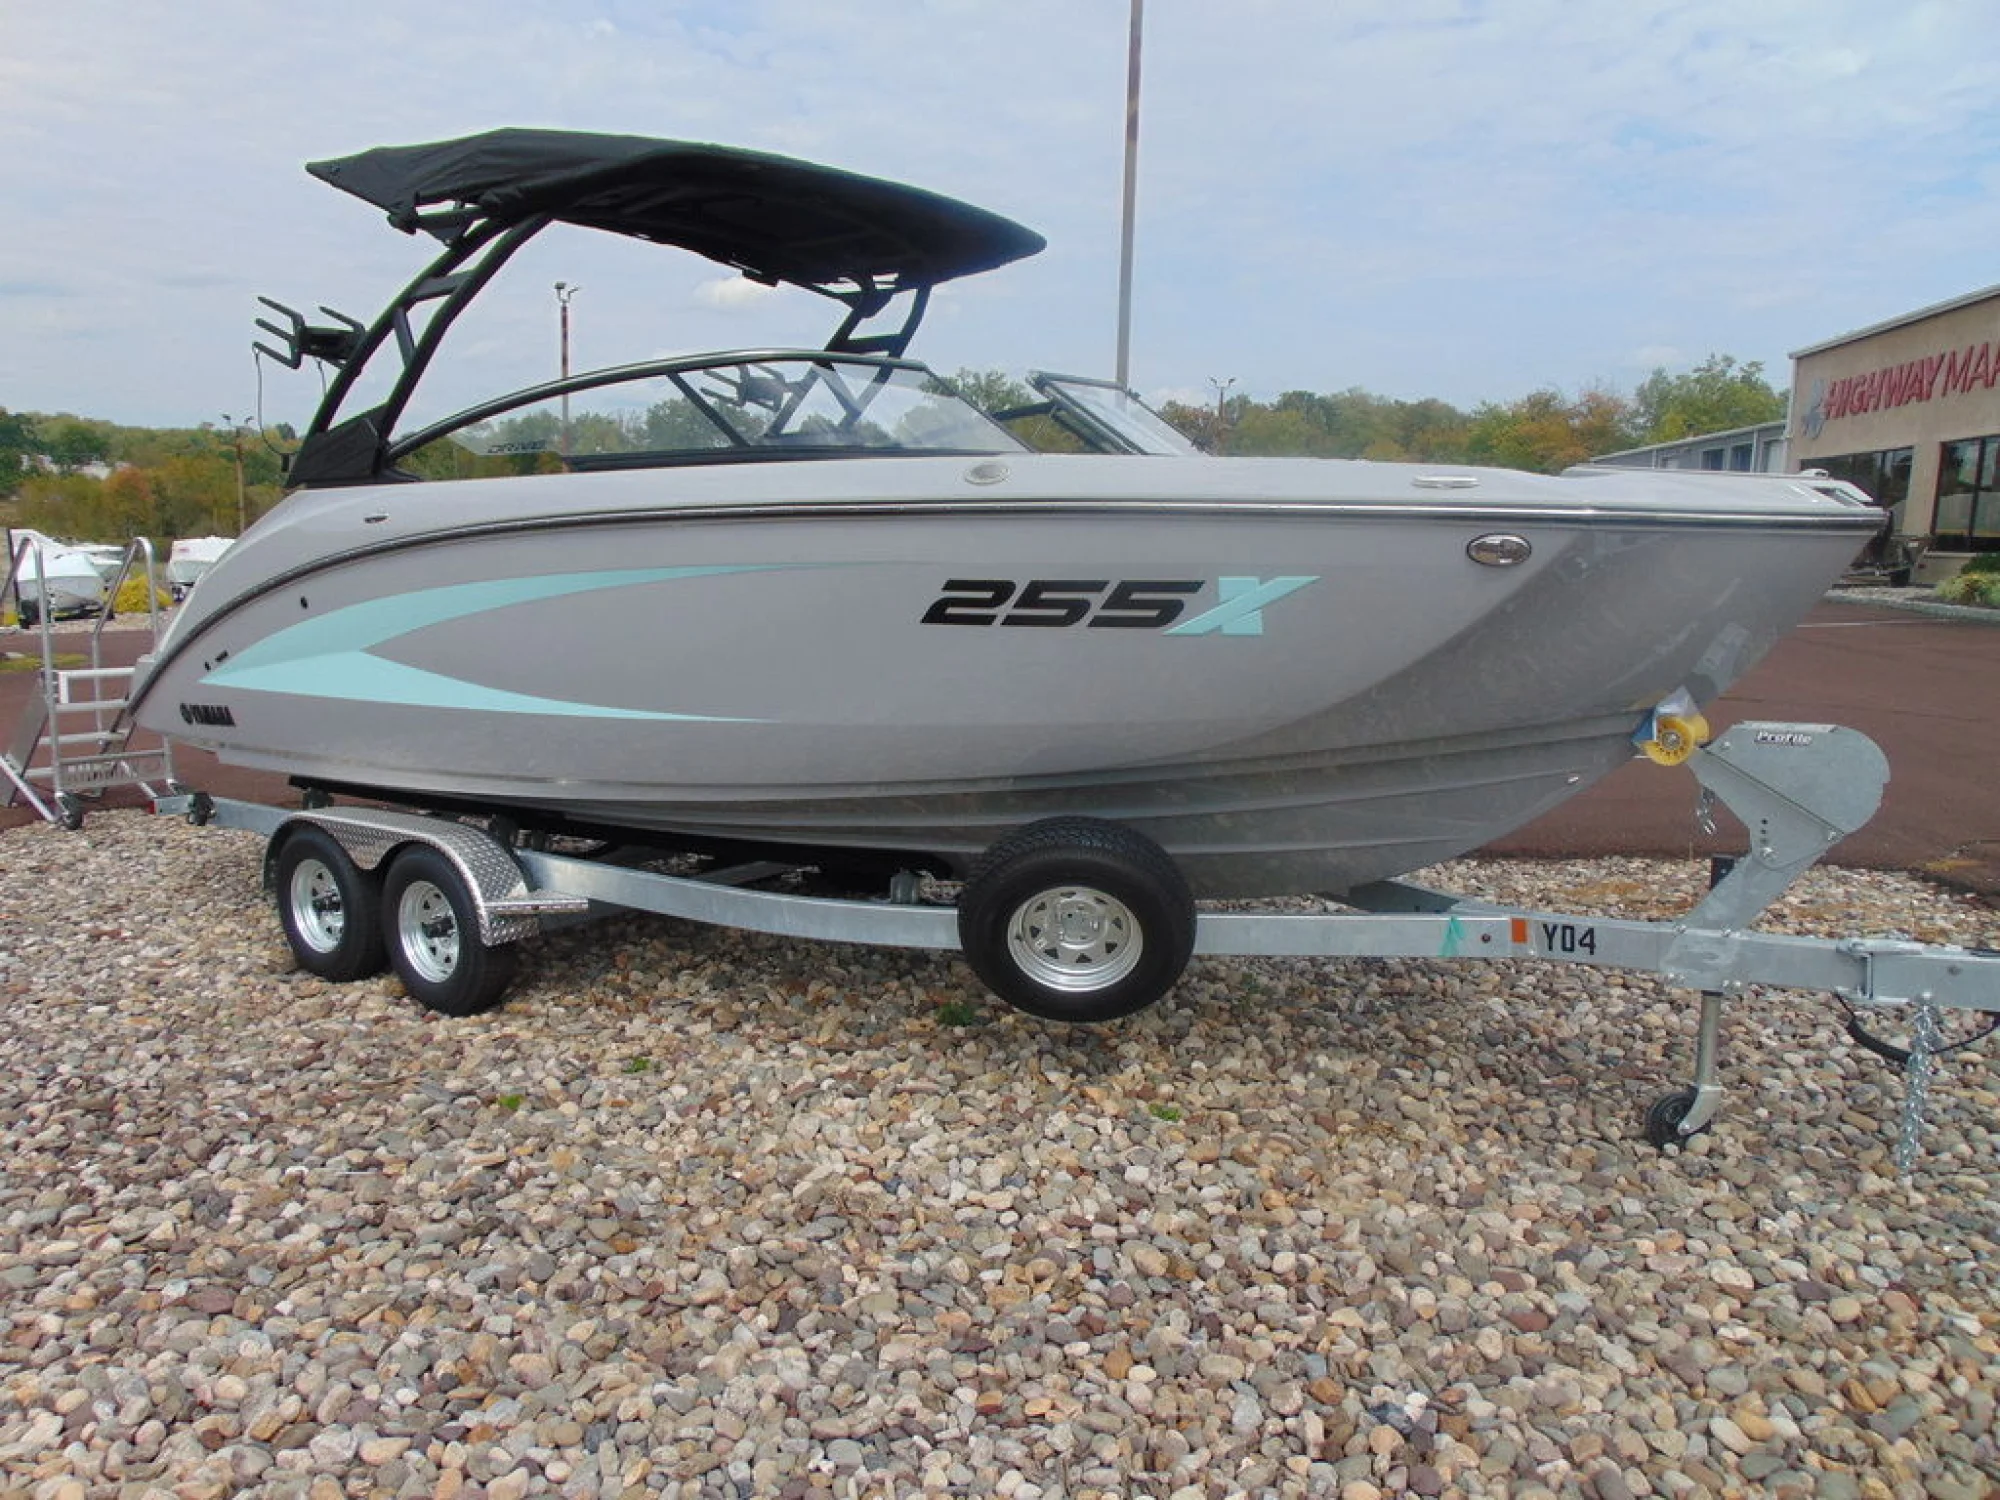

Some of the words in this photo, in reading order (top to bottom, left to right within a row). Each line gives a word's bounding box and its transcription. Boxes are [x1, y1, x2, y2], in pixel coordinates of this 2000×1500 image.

[1825, 352, 1946, 421] HIGHWAY
[189, 704, 236, 726] YAMAHA
[1755, 731, 1812, 746] Profile
